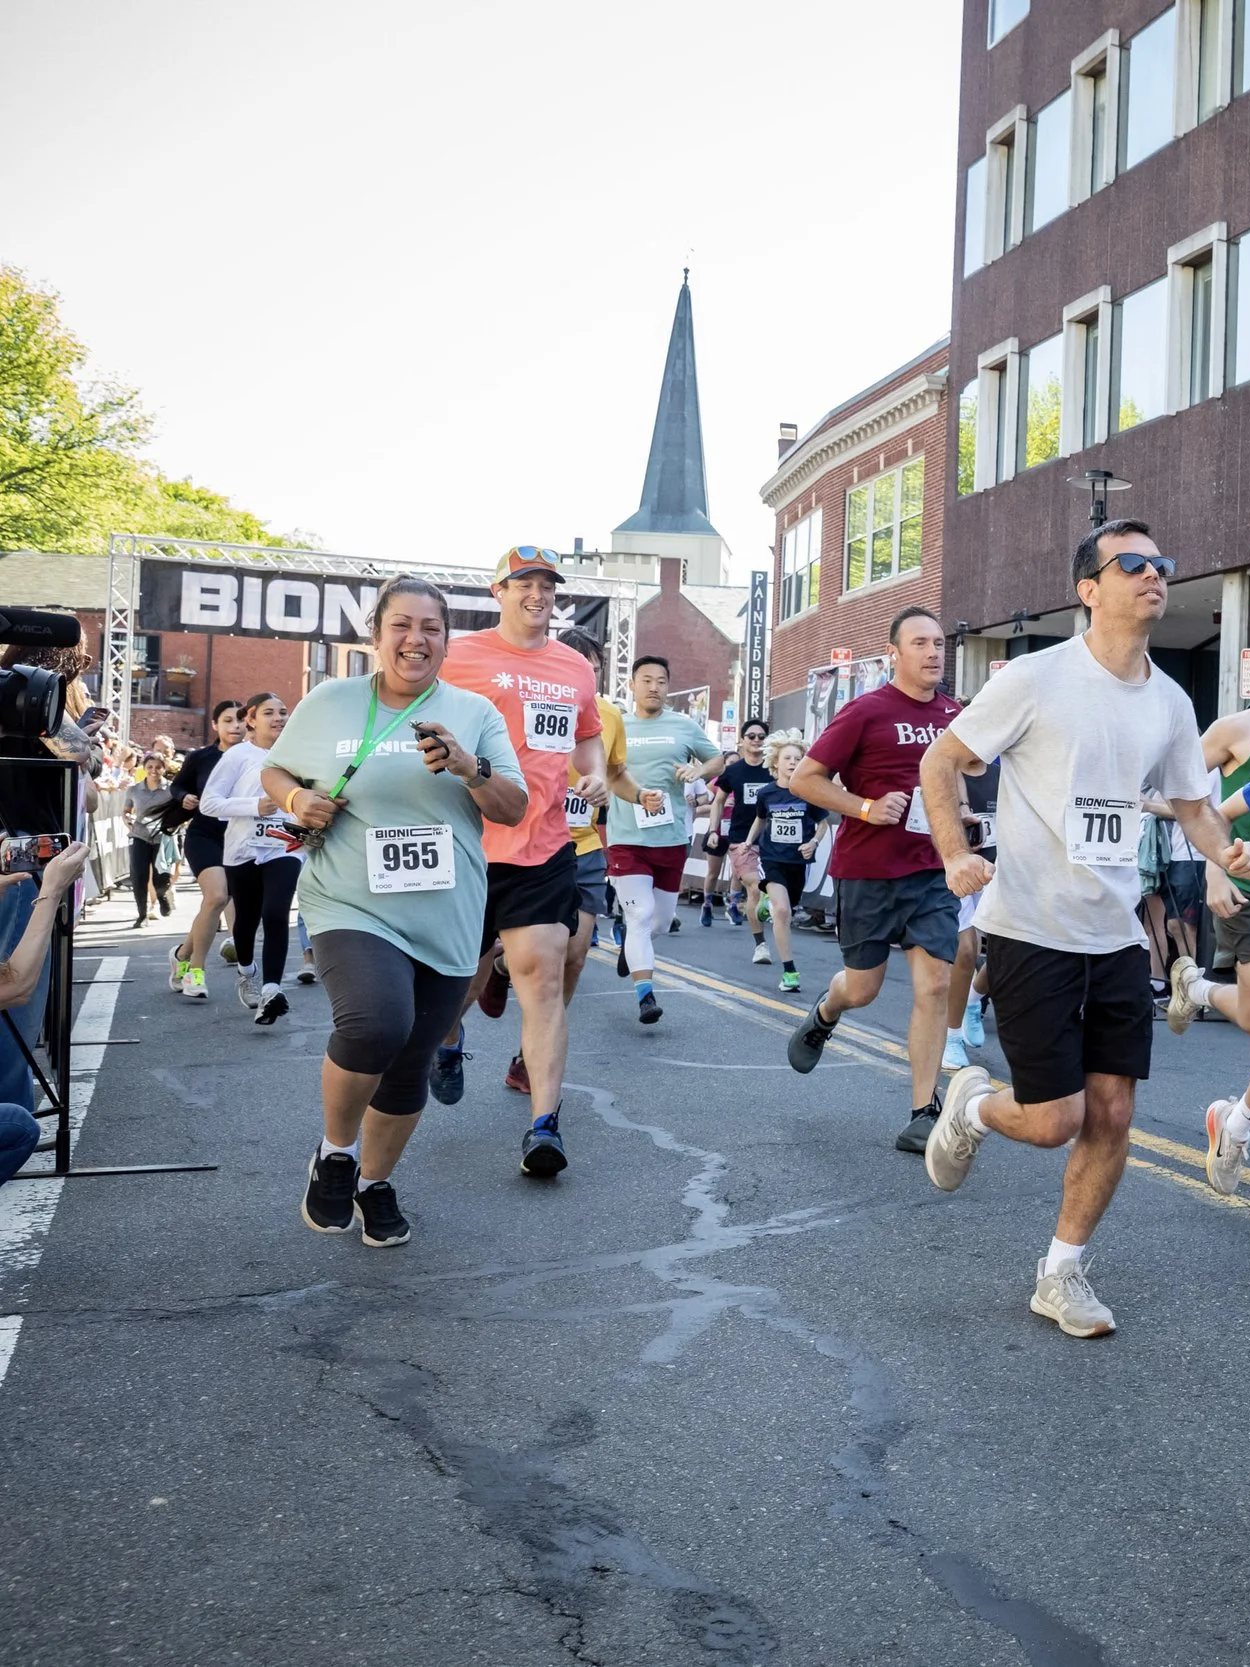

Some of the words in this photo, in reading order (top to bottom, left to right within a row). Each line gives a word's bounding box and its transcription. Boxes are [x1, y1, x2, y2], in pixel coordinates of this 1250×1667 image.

[752, 573, 764, 662] PAINTED
[517, 674, 578, 700] Hanger
[519, 690, 552, 703] CLINIC
[750, 666, 762, 718] BURR
[531, 702, 568, 713] BIONIC
[534, 713, 569, 737] 898
[894, 722, 946, 745] Bate
[336, 738, 424, 754] BINIC
[1075, 796, 1127, 809] BIONIC
[772, 810, 805, 819] patagonia
[375, 827, 432, 839] BIONIC
[776, 825, 797, 836] 328
[1082, 812, 1122, 844] 770
[382, 841, 439, 872] 955
